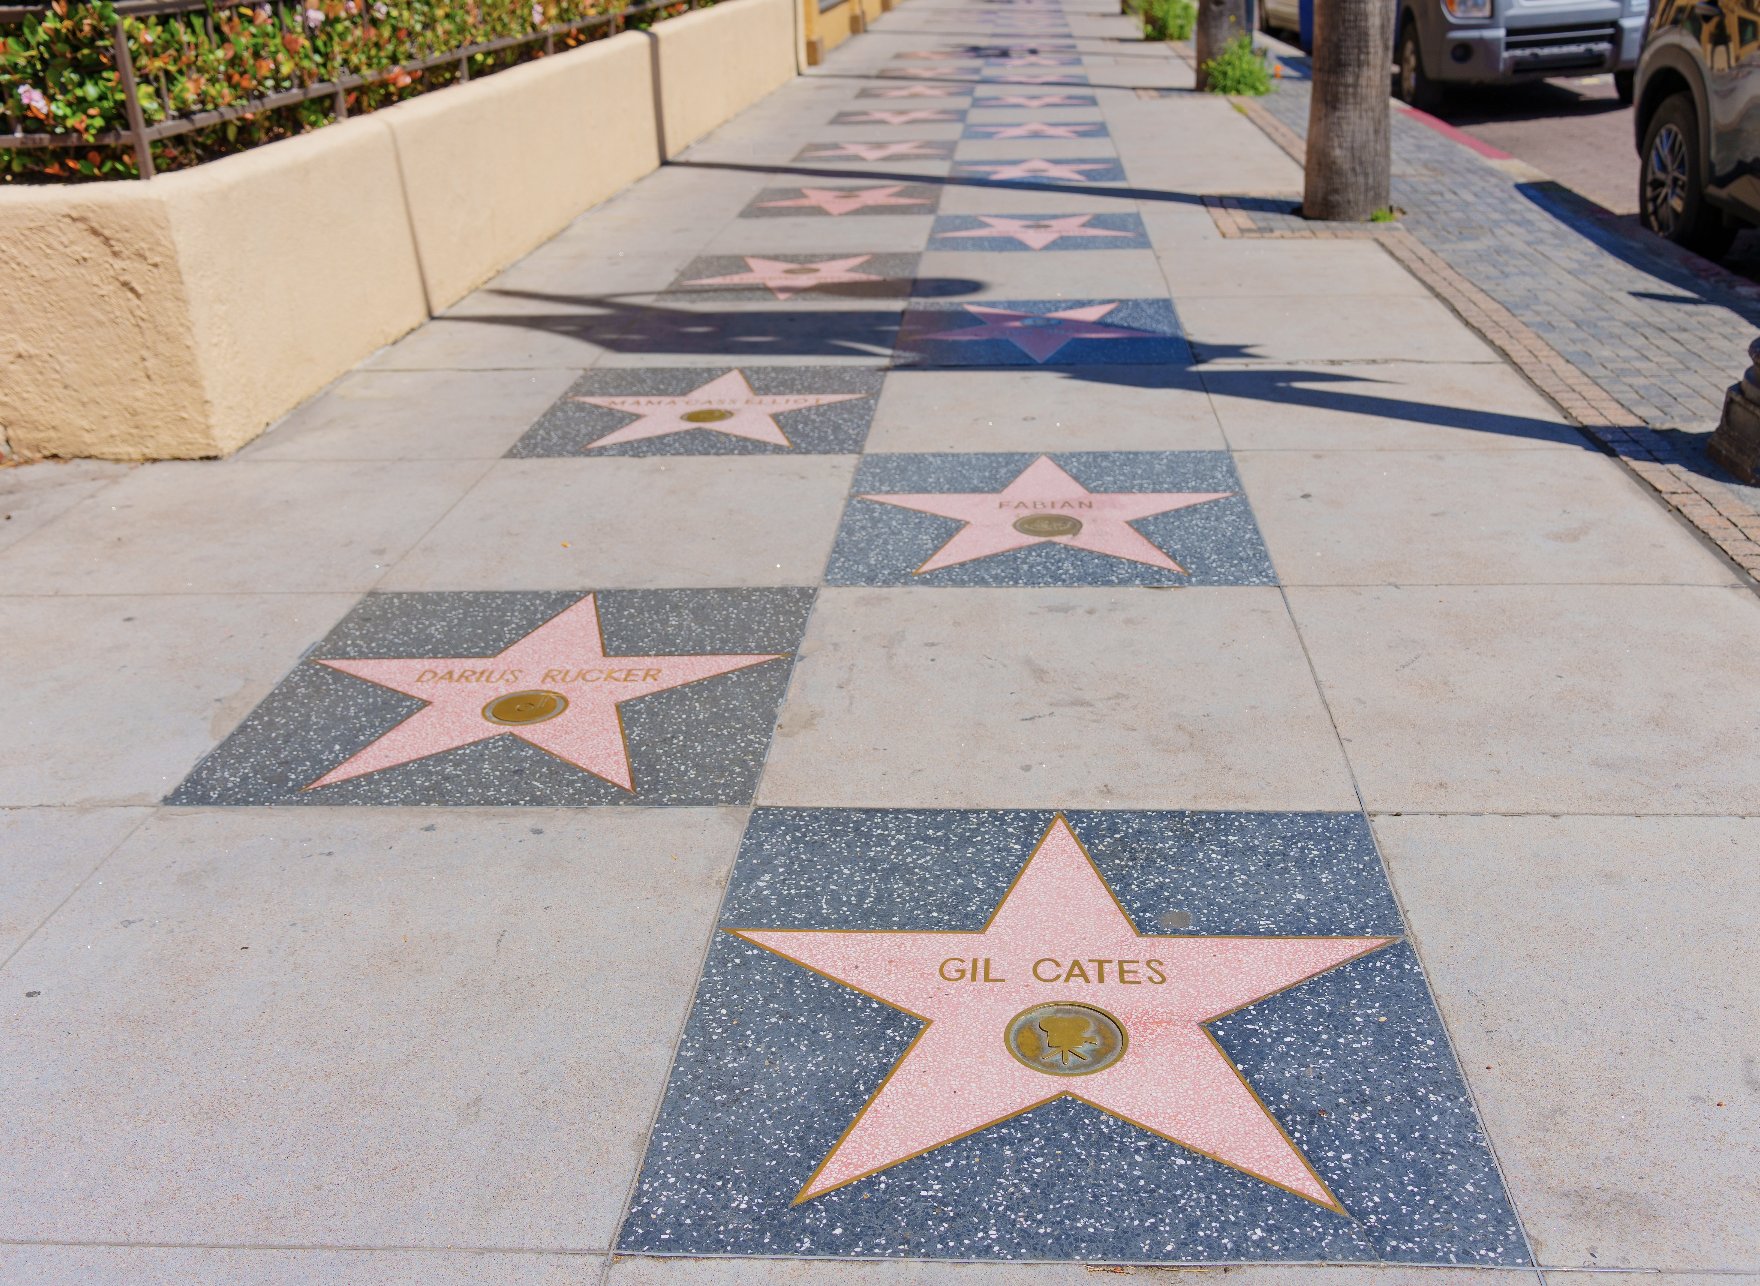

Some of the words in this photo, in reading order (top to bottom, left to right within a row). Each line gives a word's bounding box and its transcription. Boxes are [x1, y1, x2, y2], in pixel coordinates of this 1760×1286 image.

[998, 500, 1094, 509] FABIAN
[414, 668, 524, 684] DARIUS
[540, 667, 663, 684] RUCKER
[938, 957, 1006, 983] GIL
[1031, 957, 1168, 985] CATES
